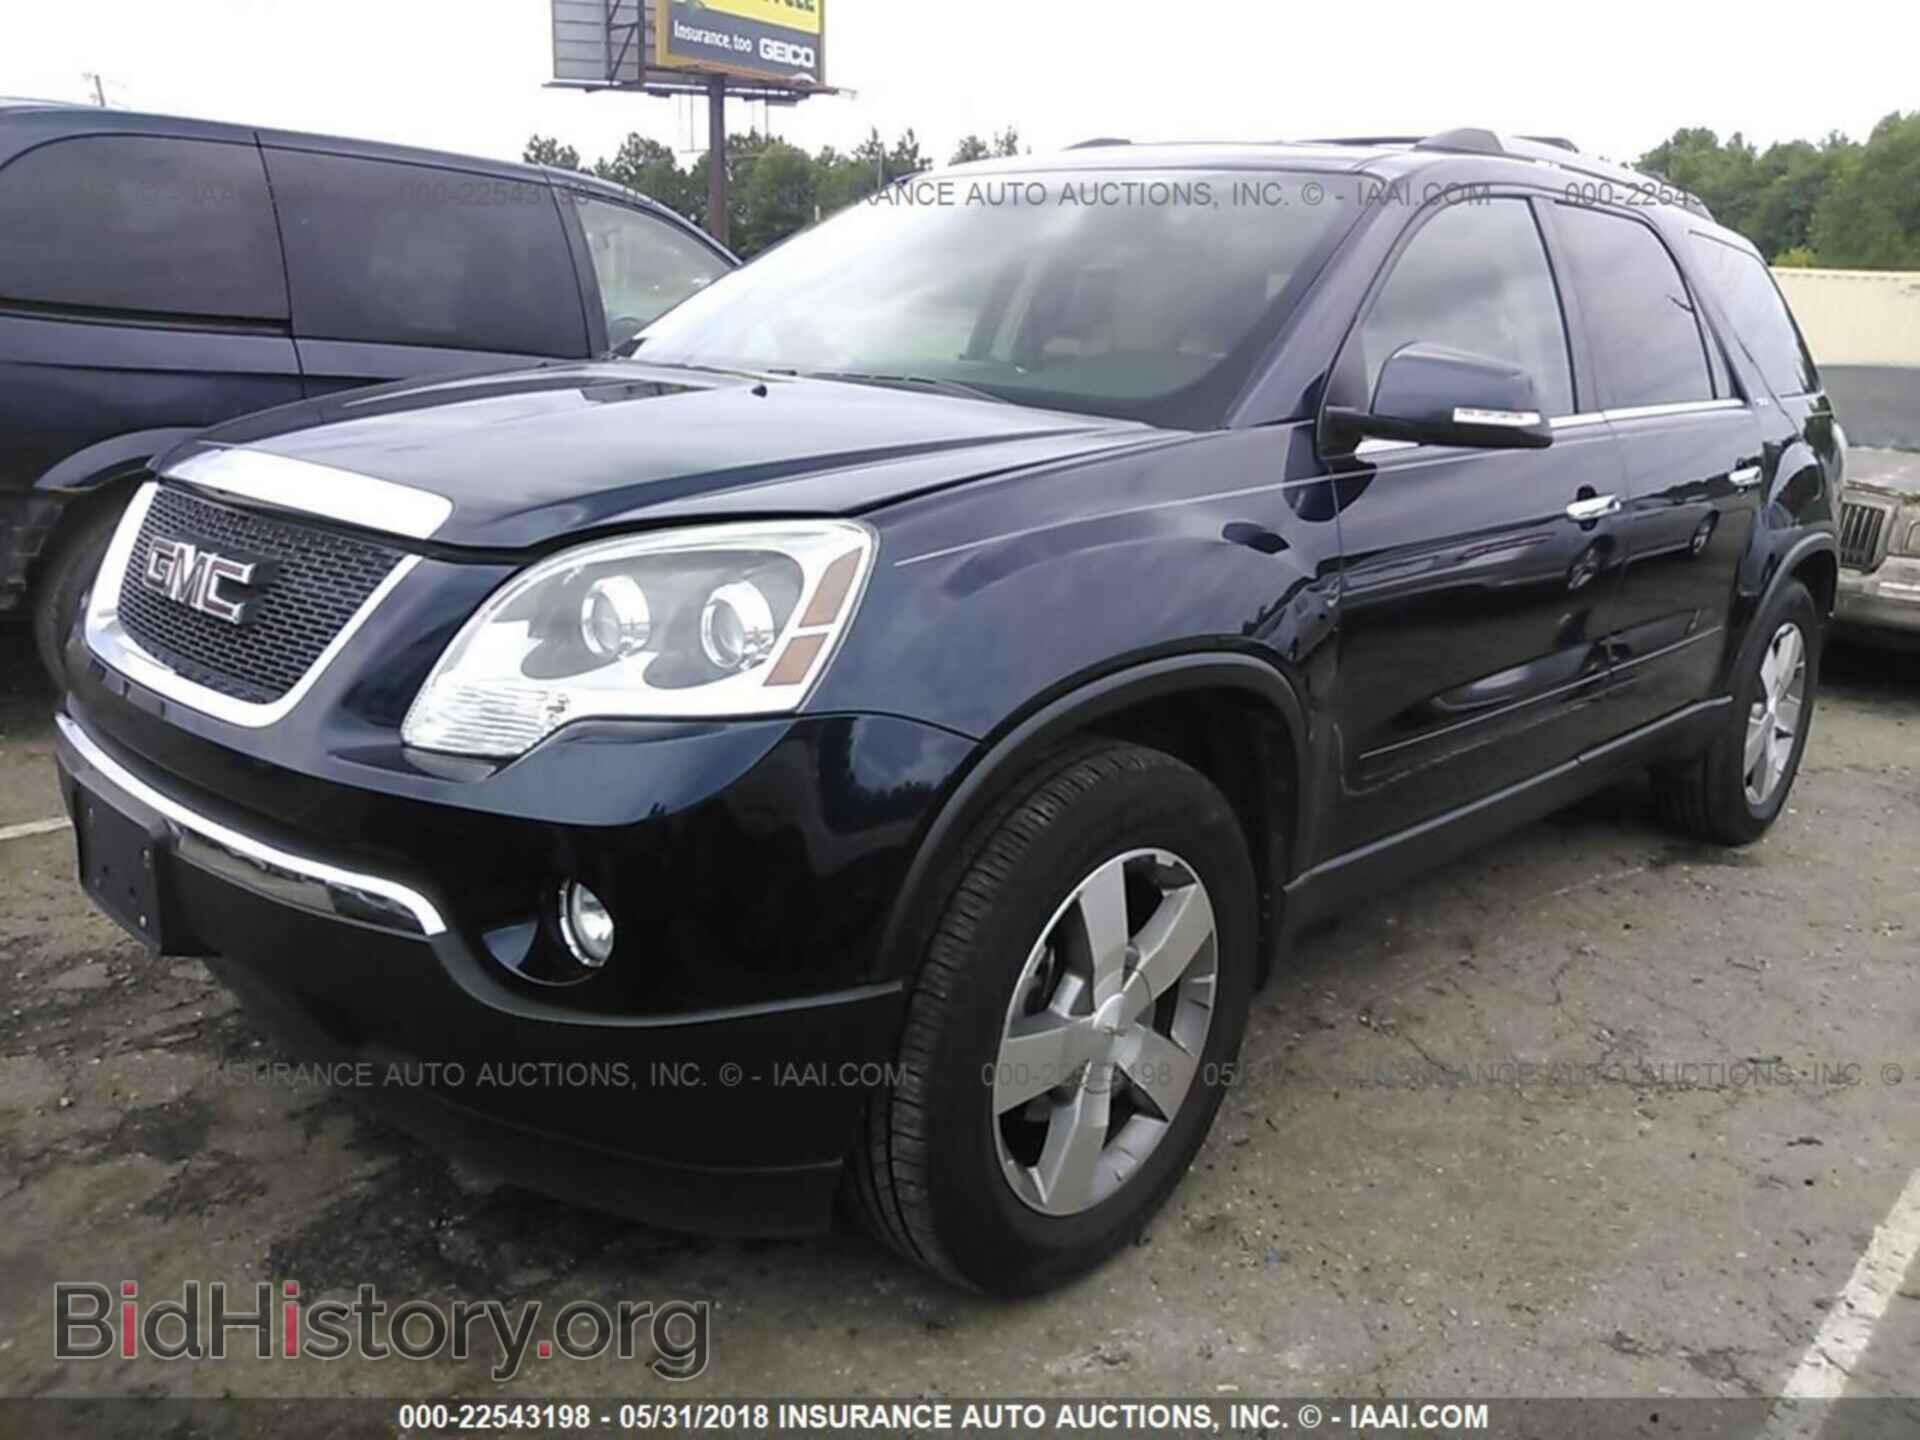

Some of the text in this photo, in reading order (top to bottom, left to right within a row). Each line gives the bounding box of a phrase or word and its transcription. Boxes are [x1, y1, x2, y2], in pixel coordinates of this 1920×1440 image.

[733, 34, 753, 53] too
[759, 37, 815, 68] GEICO
[144, 536, 256, 625] GMC
